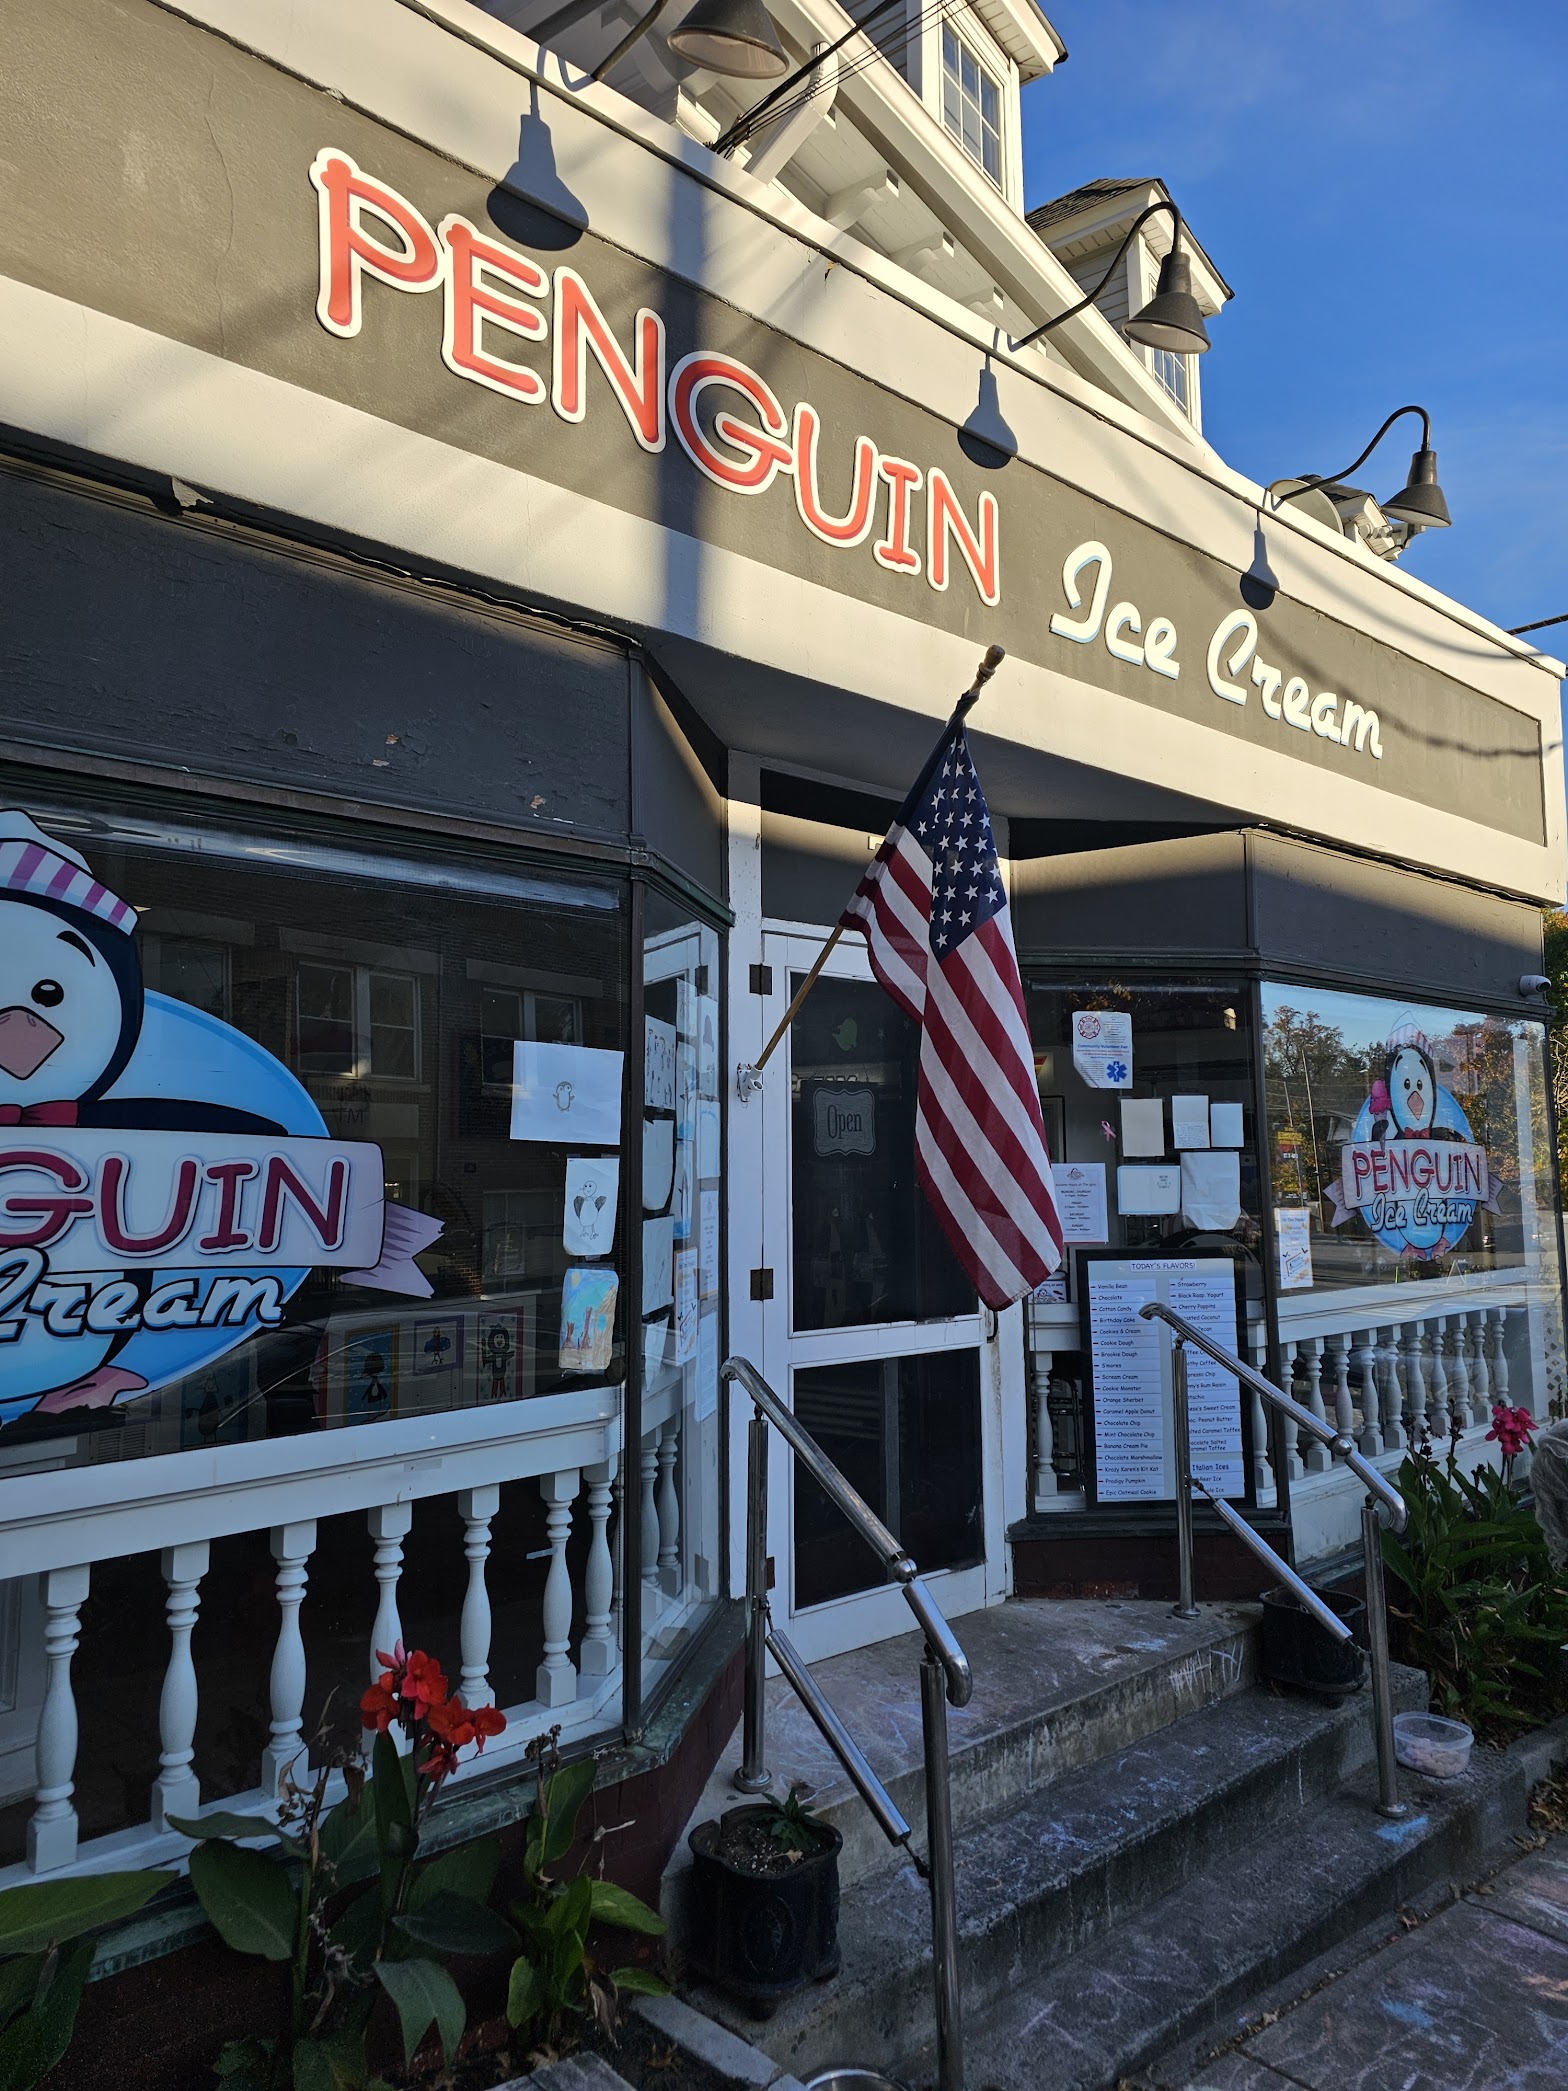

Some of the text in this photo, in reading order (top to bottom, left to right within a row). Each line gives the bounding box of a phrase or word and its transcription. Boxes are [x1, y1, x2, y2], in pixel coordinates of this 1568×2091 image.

[309, 147, 1000, 607] PENGUIN
[1050, 540, 1384, 759] Ice Cream
[827, 1104, 863, 1140] Open
[1352, 1147, 1483, 1200] PENGUIN
[1371, 1188, 1474, 1233] Ice Cream
